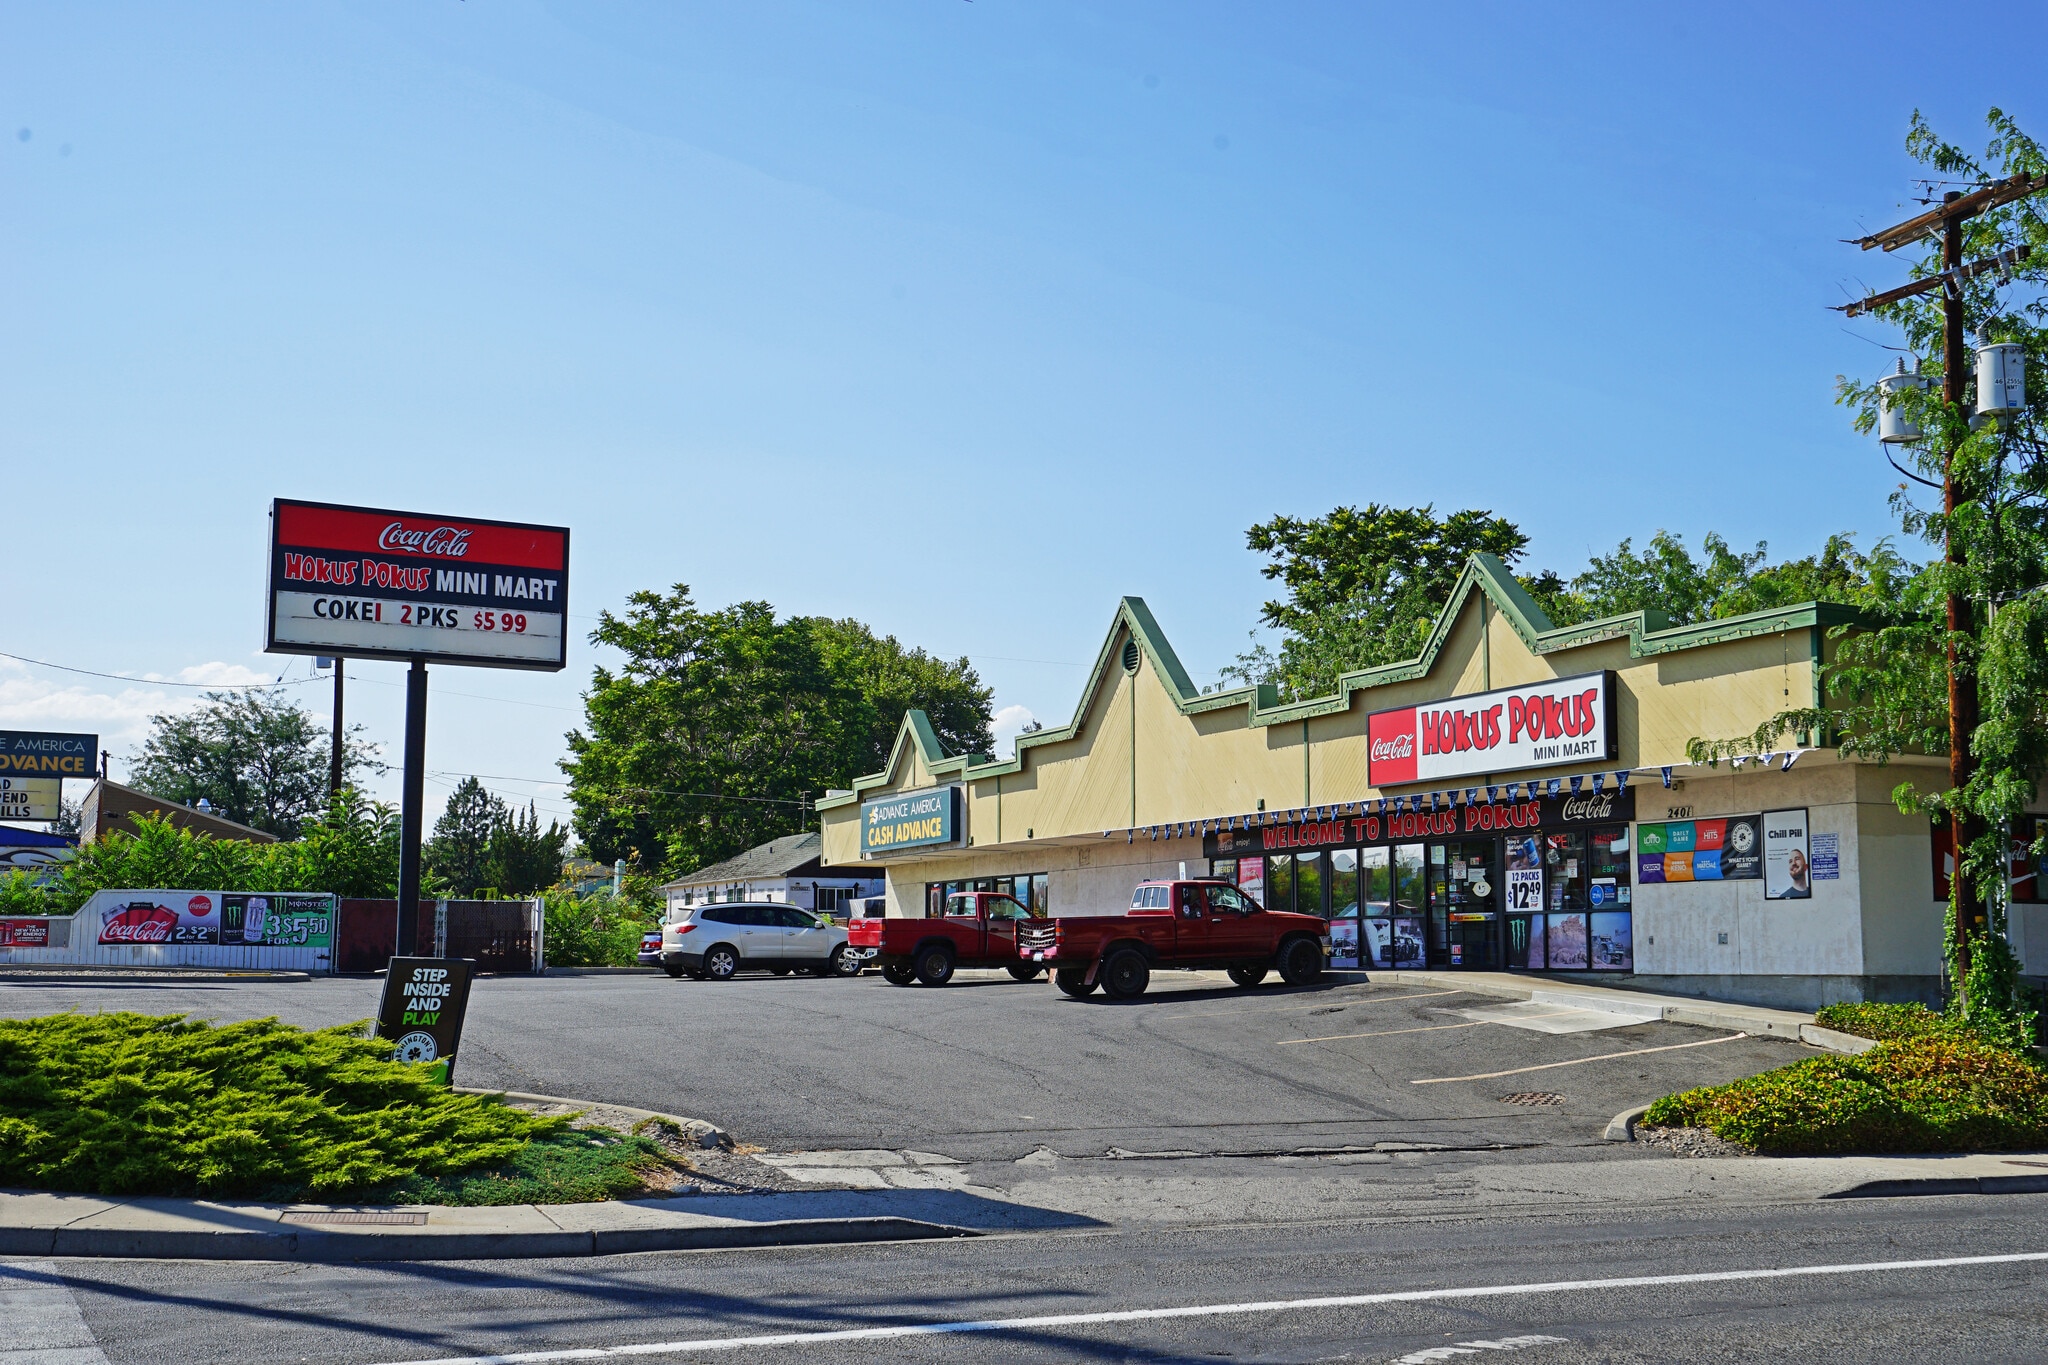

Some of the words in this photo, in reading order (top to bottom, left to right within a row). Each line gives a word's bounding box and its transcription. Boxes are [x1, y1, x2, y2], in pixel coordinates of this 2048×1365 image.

[378, 521, 474, 557] Coca-Cola
[284, 552, 358, 586] HOKUS
[362, 558, 431, 591] POKUS
[436, 569, 487, 596] MINI
[494, 574, 557, 601] MART
[1421, 703, 1503, 756] HOKUS
[1508, 688, 1598, 744] POKUS
[14, 739, 86, 752] AMERICA
[1371, 733, 1415, 762] Coca-Cola
[1533, 745, 1560, 761] MINI
[1563, 740, 1597, 757] MART
[0, 754, 85, 772] DVANCE
[878, 803, 908, 821] ADVANCE
[910, 797, 941, 816] AMERICA
[1562, 793, 1614, 821] Coca-Cola
[1667, 807, 1690, 818] 2401
[868, 825, 894, 846] CASH
[896, 817, 941, 843] ADVANCE
[1262, 820, 1345, 850] WELCOME
[1351, 816, 1380, 842] TO
[1387, 809, 1457, 839] HOKUS
[1464, 801, 1541, 832] POKUS
[1768, 829, 1787, 839] Chill
[1789, 828, 1803, 838] Pill
[1512, 872, 1519, 881] 12
[1521, 871, 1539, 881] PACKS
[288, 900, 328, 908] MONSTER
[102, 920, 171, 941] Coca-Cola
[175, 926, 186, 940] 2
[266, 915, 281, 935] 3
[266, 937, 290, 945] FOR
[412, 968, 448, 982] STEP
[403, 982, 451, 997] INSIDE
[405, 997, 442, 1011] AND
[402, 1012, 441, 1025] PLAY
